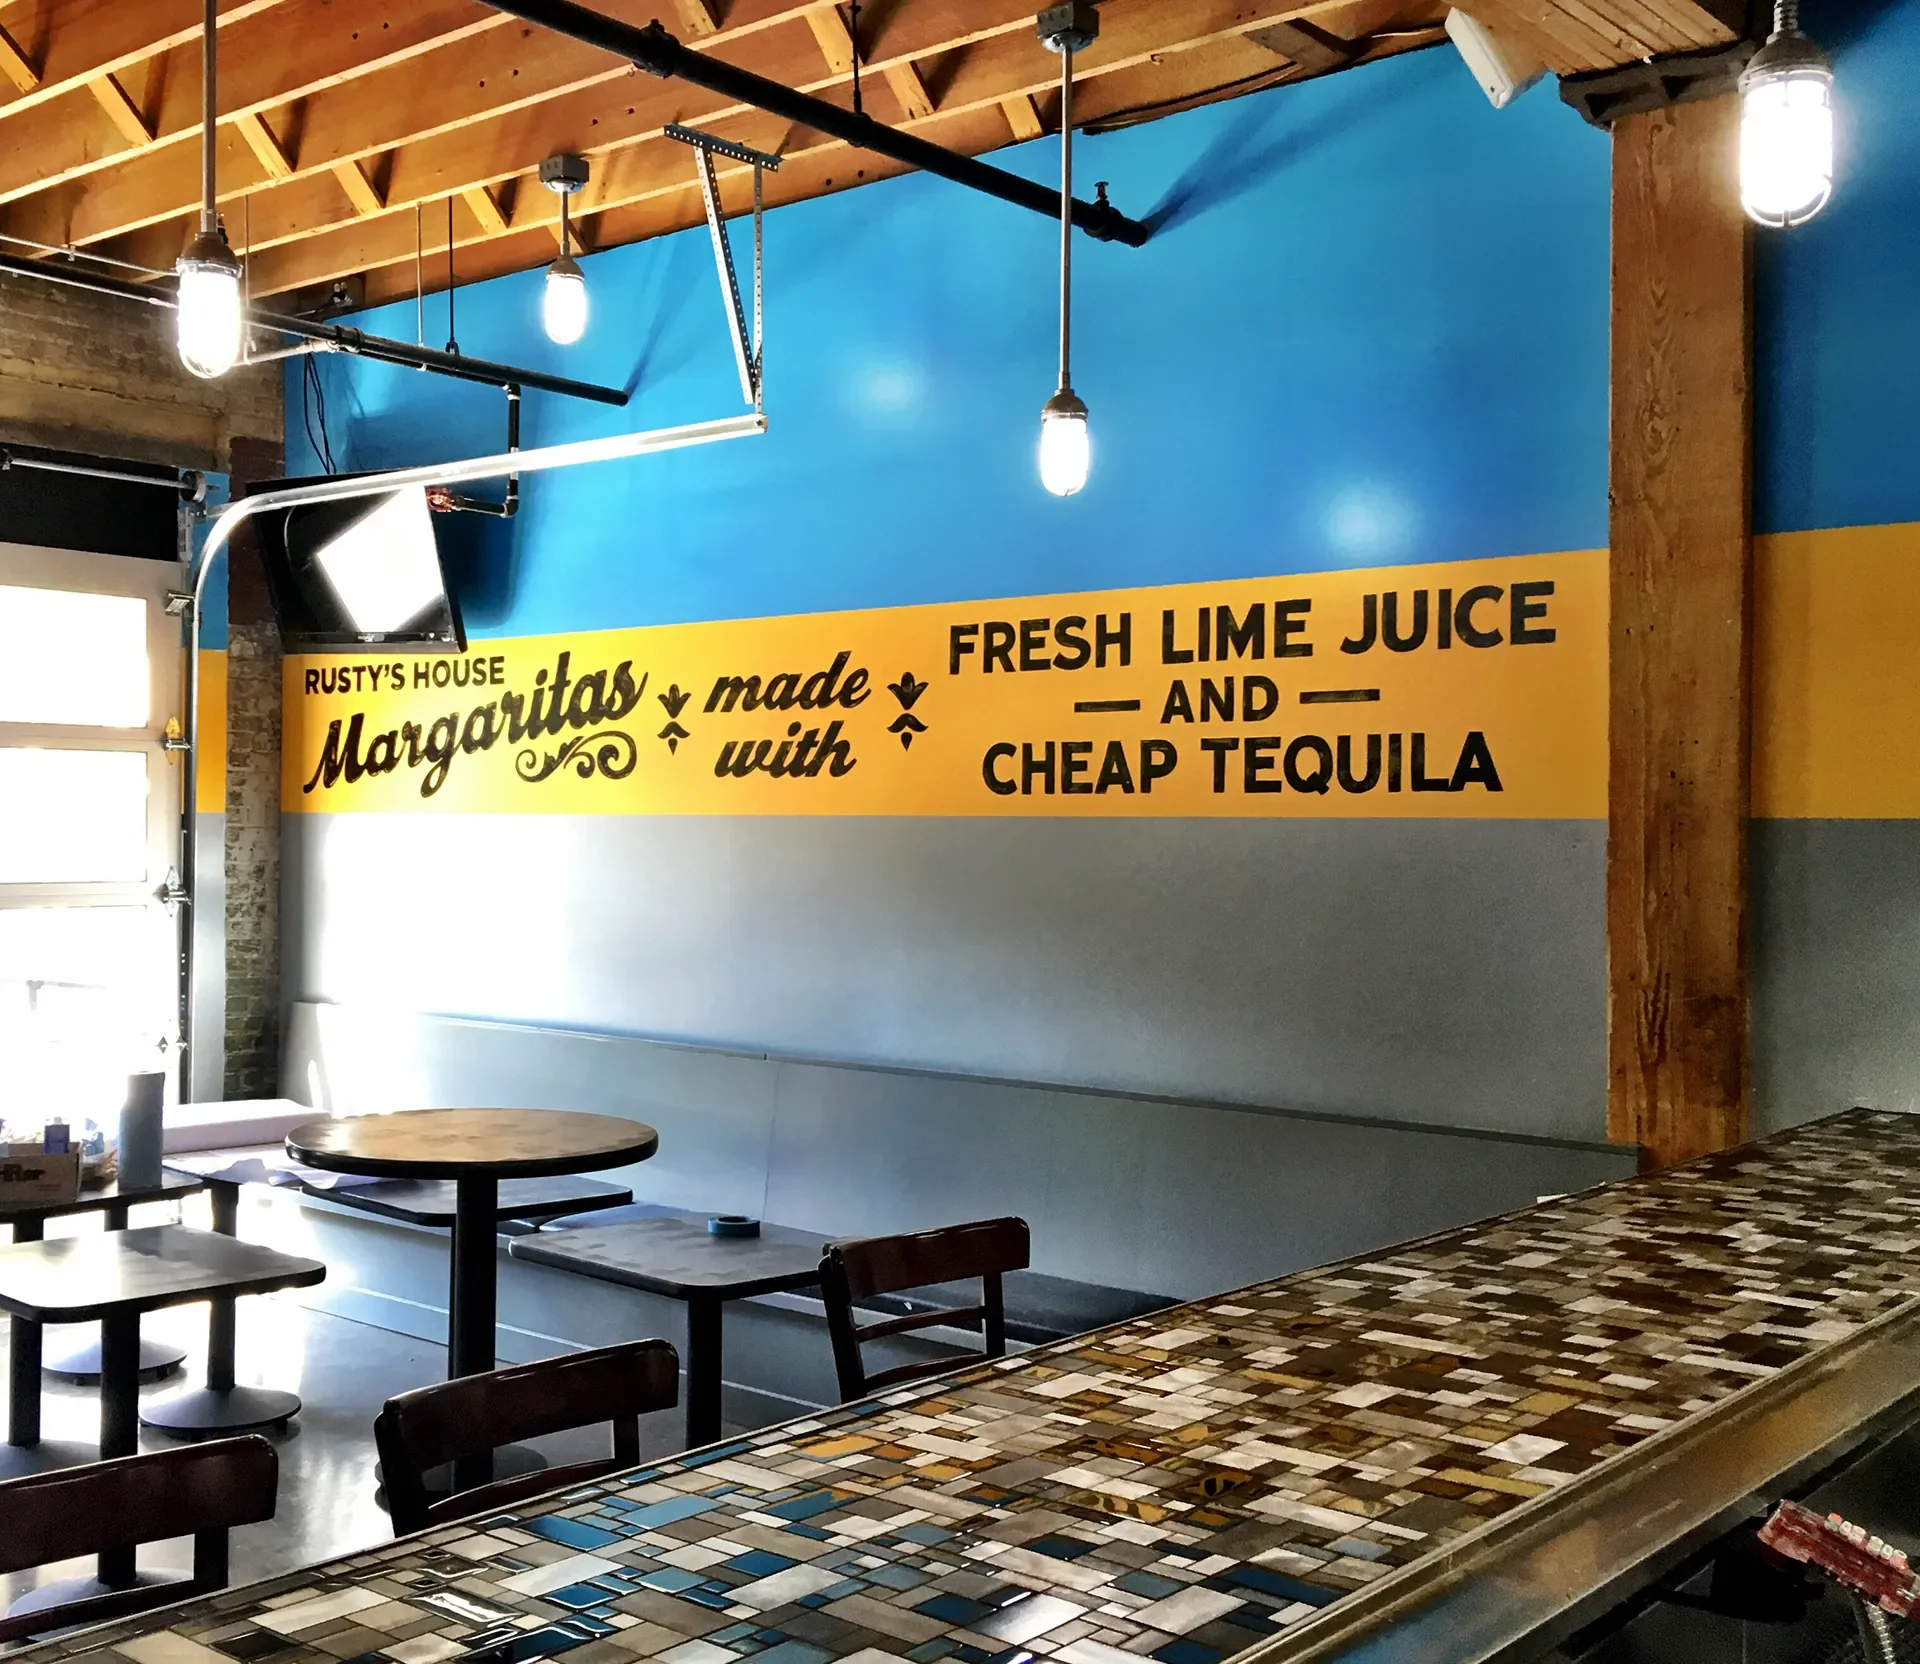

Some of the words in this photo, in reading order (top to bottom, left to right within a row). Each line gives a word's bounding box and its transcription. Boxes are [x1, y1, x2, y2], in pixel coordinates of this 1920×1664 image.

[949, 612, 1132, 676] FRESH
[1161, 598, 1314, 666] LIME
[1339, 580, 1557, 655] JUICE
[304, 661, 406, 696] RUSTY'S
[413, 655, 506, 690] HOUSE
[703, 650, 872, 713] made
[1160, 675, 1279, 725] AND
[302, 650, 650, 799] Margaritas
[714, 720, 858, 779] with
[982, 739, 1178, 796] CHEAP
[1200, 730, 1504, 796] TEQUILA
